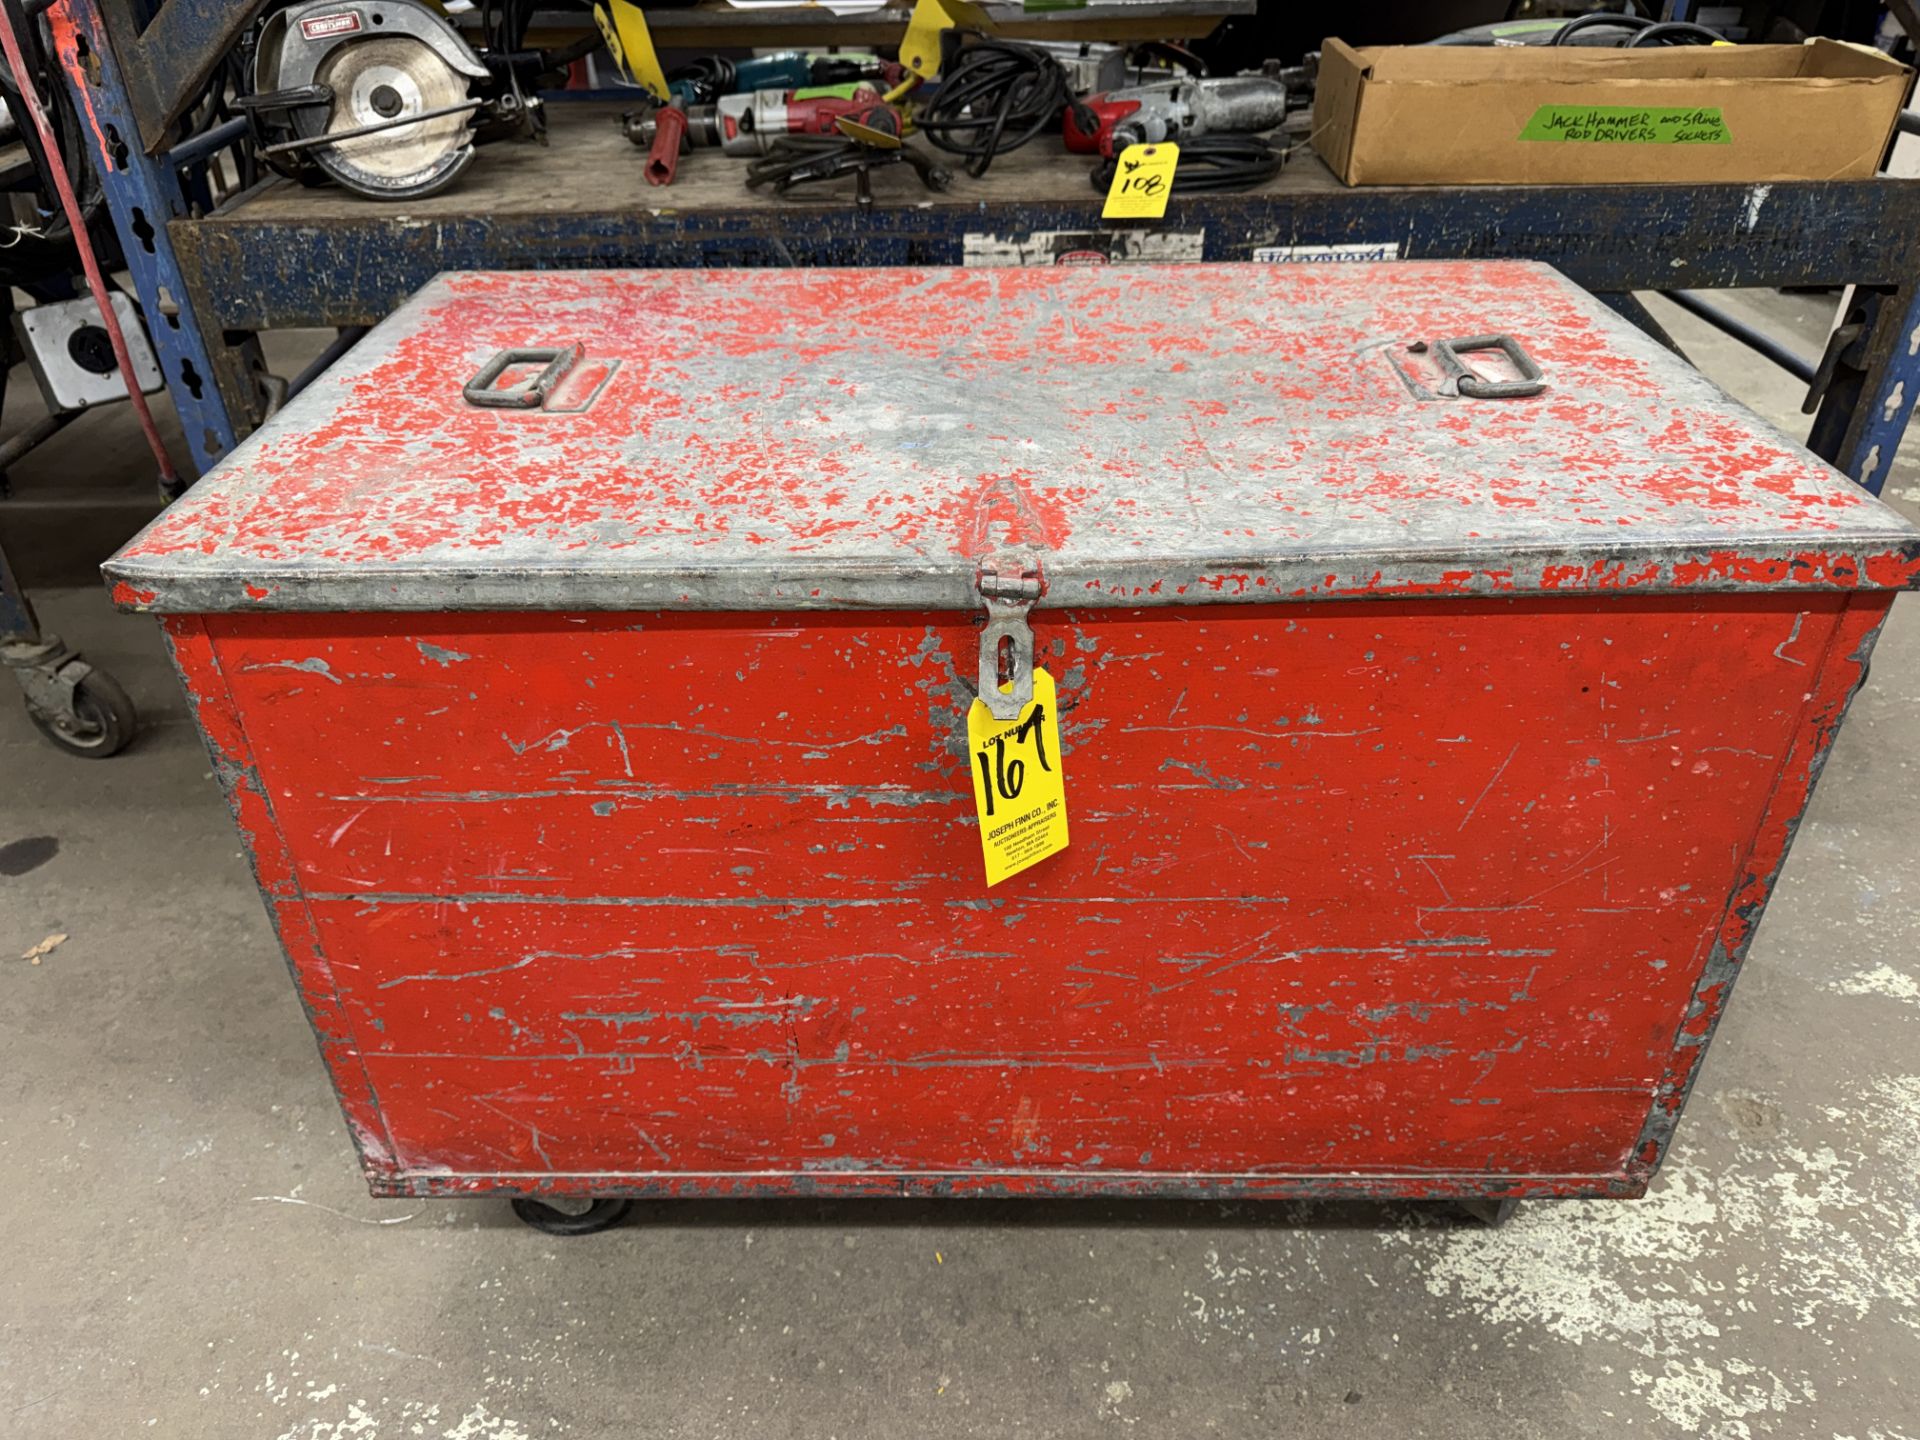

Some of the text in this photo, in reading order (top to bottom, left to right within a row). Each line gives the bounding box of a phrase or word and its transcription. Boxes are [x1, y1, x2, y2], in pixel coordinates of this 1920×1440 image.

[1564, 127, 1592, 141] ROD
[1594, 127, 1657, 142] DRIVERS
[1121, 174, 1166, 196] 108
[983, 733, 1002, 749] LOT
[976, 704, 1052, 816] 167
[987, 821, 1014, 841] JOSEPH
[1014, 812, 1031, 828] FINN
